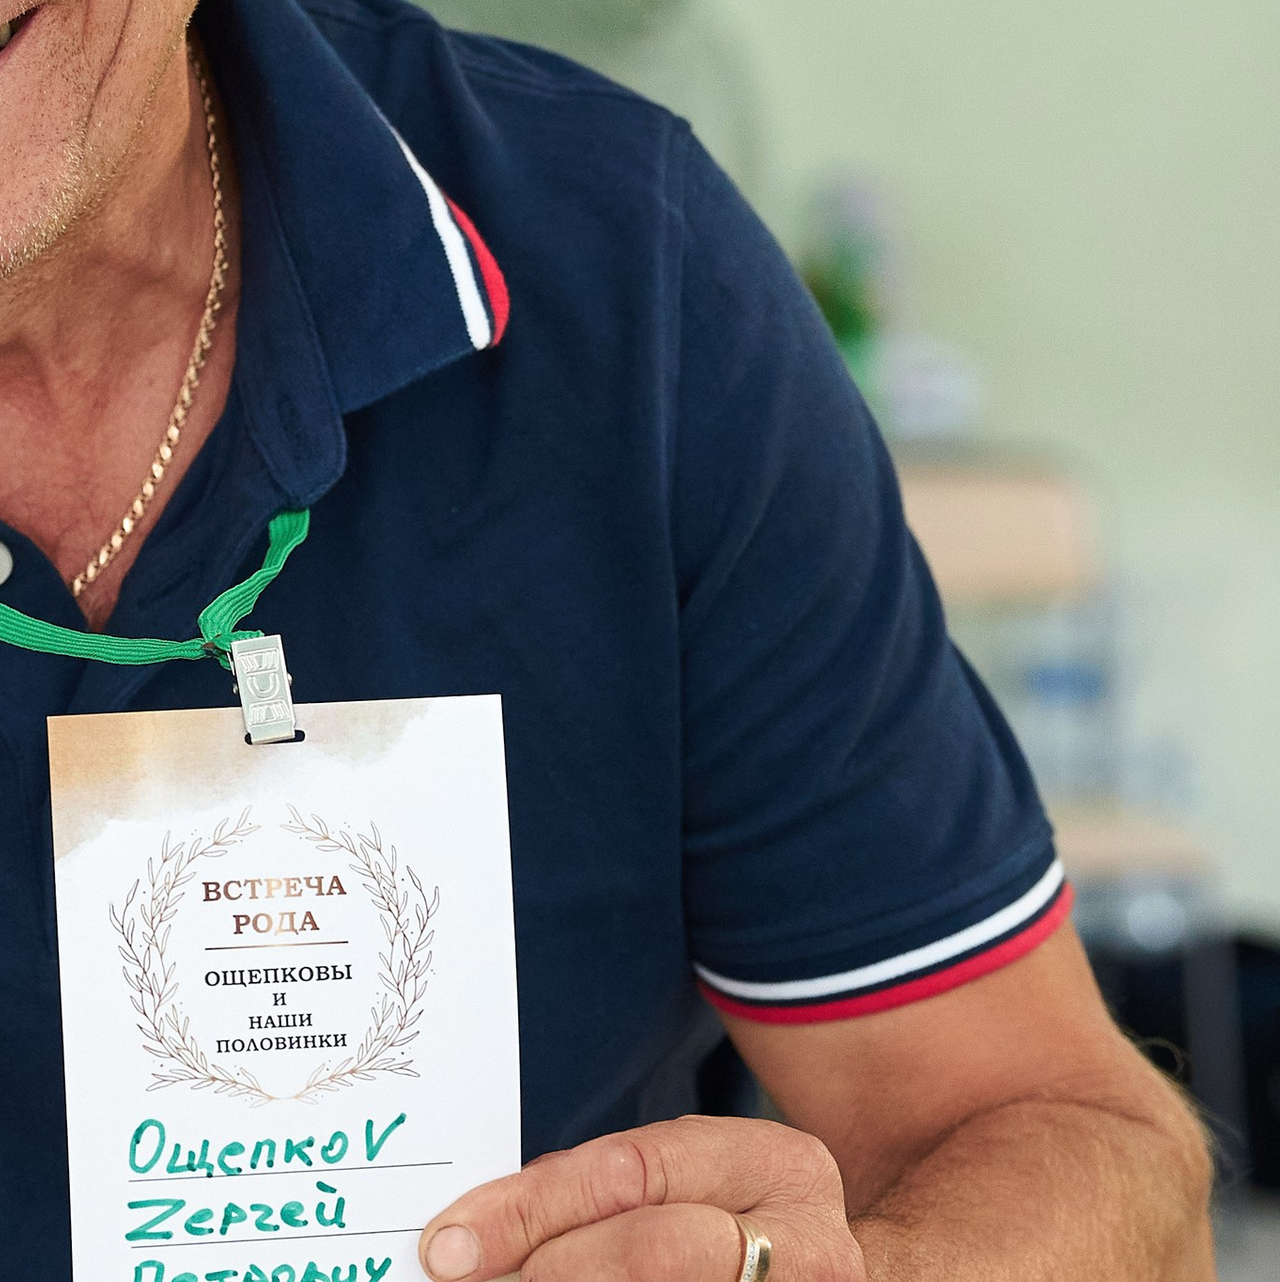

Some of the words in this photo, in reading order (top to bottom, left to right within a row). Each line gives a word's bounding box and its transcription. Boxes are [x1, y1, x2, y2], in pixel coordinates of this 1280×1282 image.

[202, 875, 347, 902] ВСТРЕЧА
[232, 911, 320, 935] РОДА
[204, 964, 353, 988] ОЩЕПКОВЫ
[272, 992, 287, 1007] И
[248, 1013, 313, 1030] НАШИ
[216, 1033, 348, 1054] ПОЛОВИНКИ
